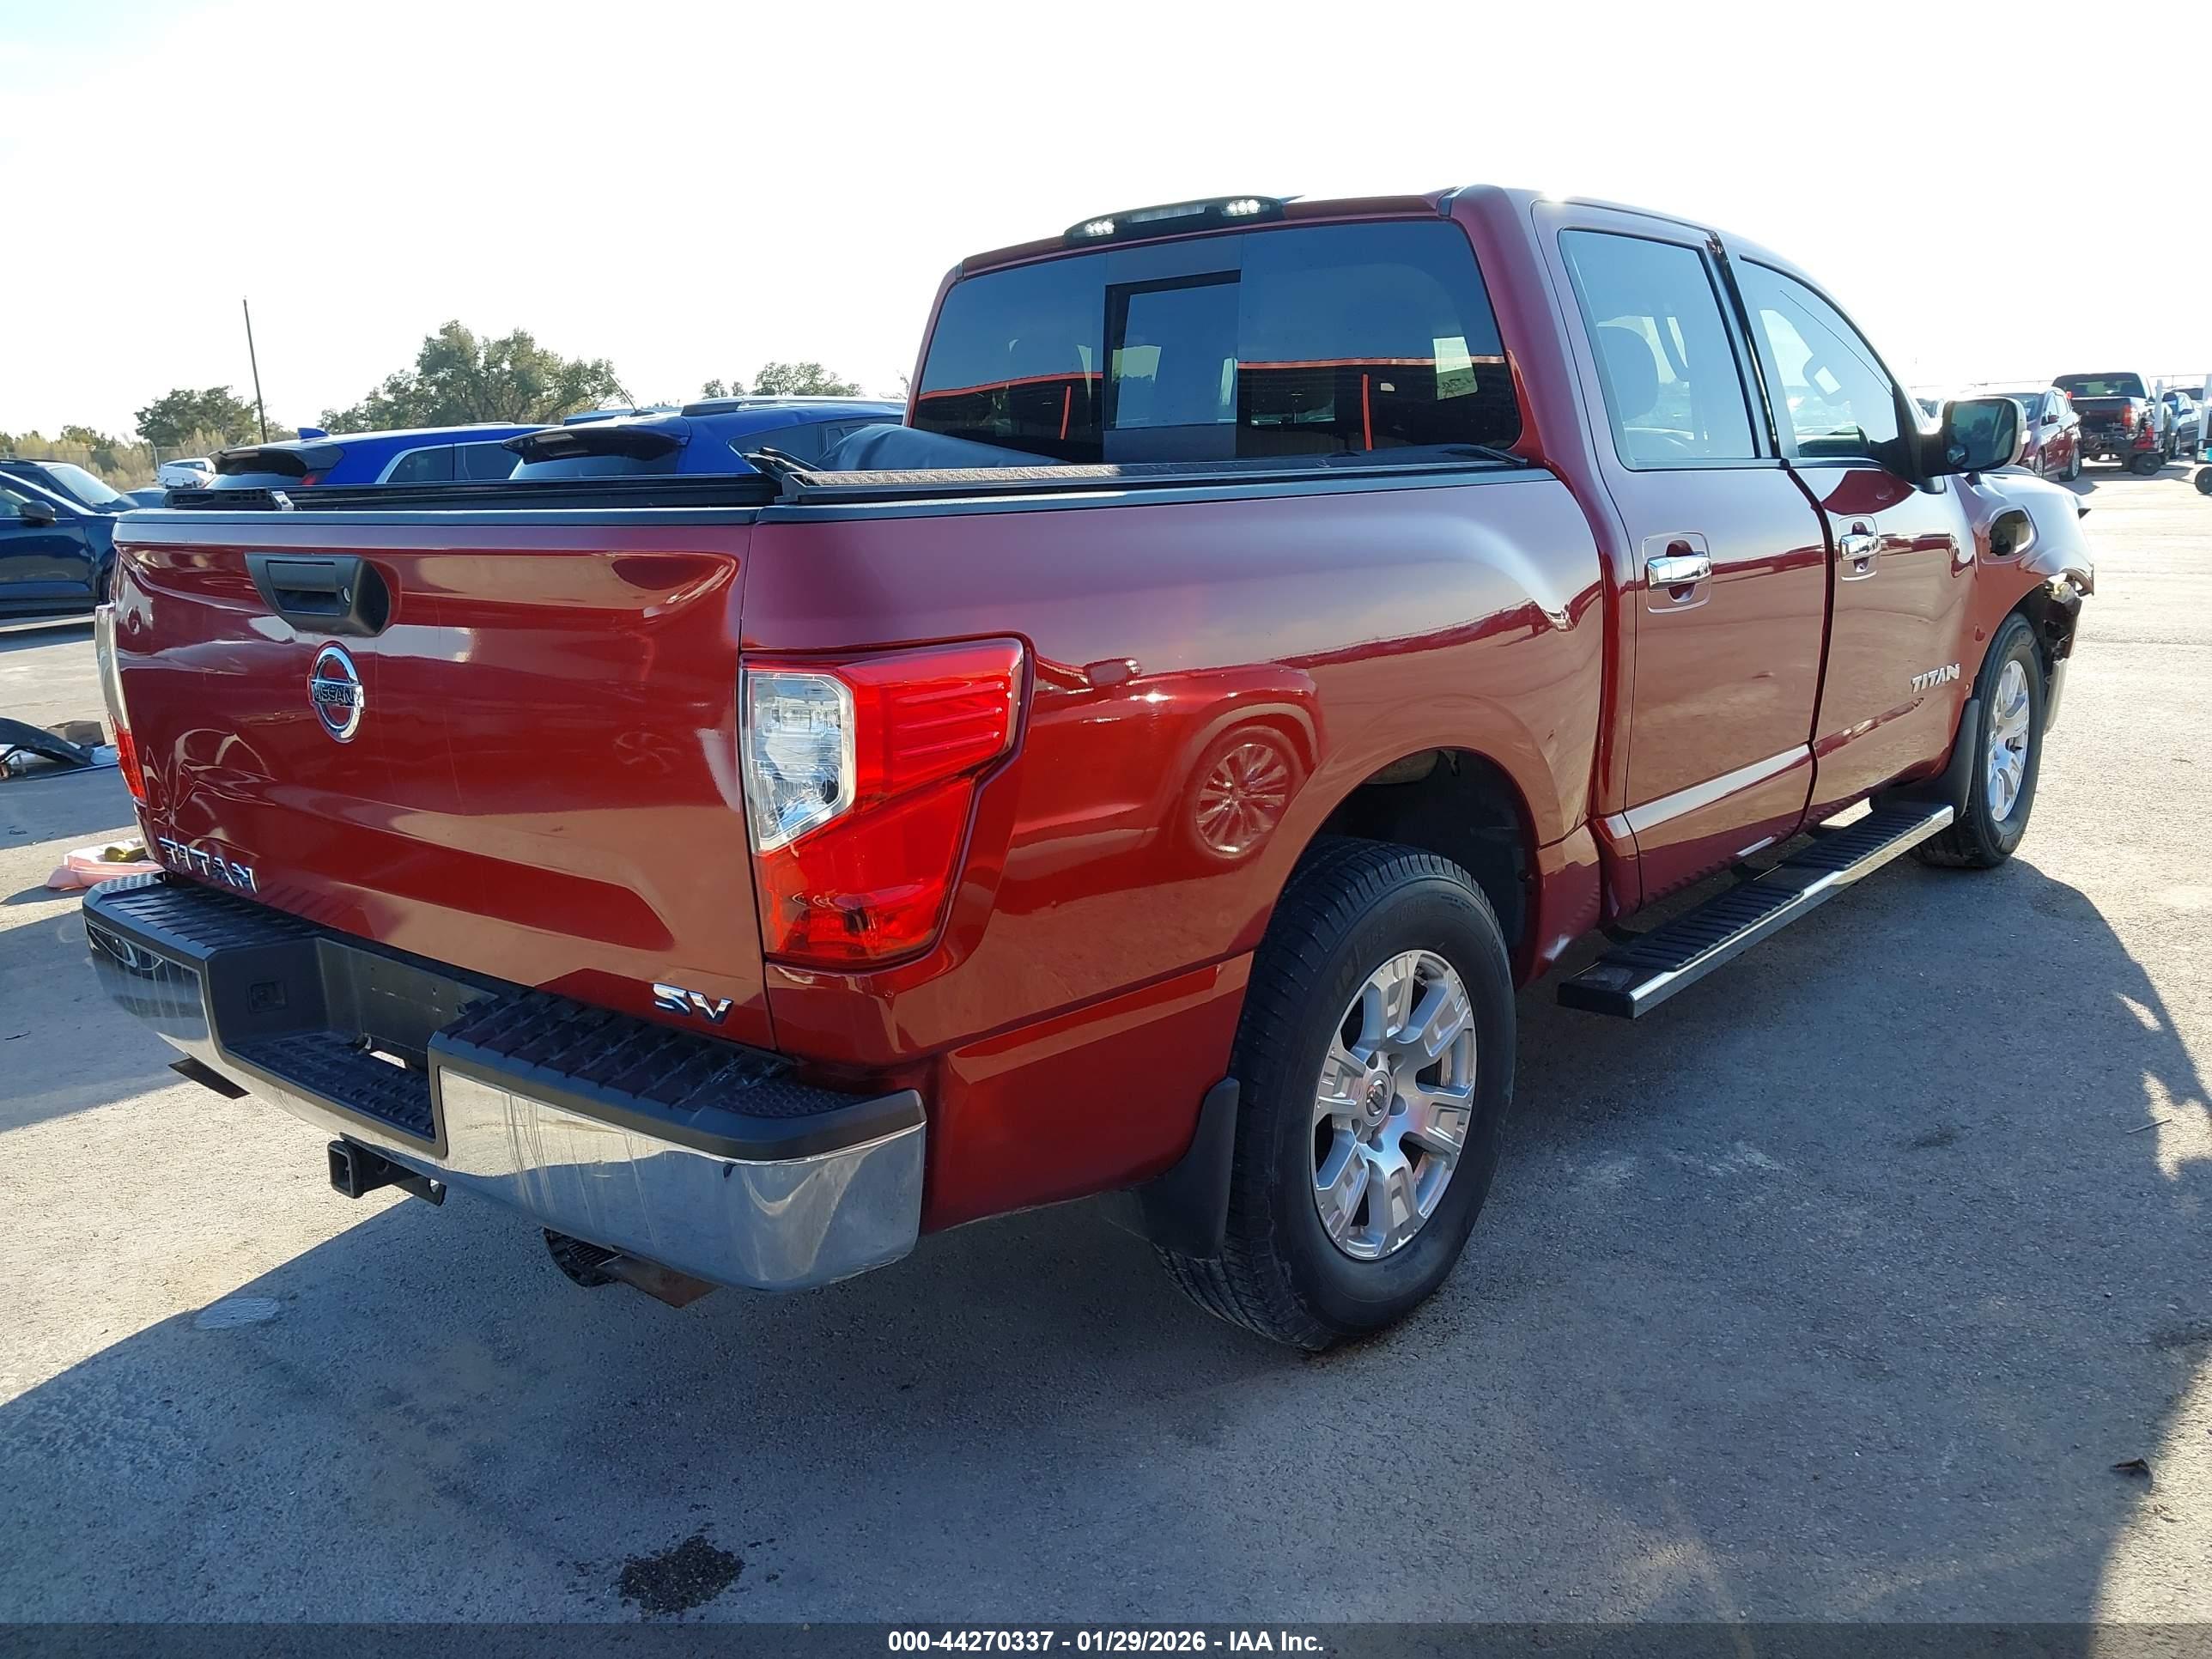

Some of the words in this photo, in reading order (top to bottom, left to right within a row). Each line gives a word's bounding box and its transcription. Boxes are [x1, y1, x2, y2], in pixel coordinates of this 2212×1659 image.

[313, 684, 356, 706] NISSAN
[1911, 663, 1960, 694] TITAN
[158, 836, 258, 894] TITAN
[652, 982, 732, 1025] SV
